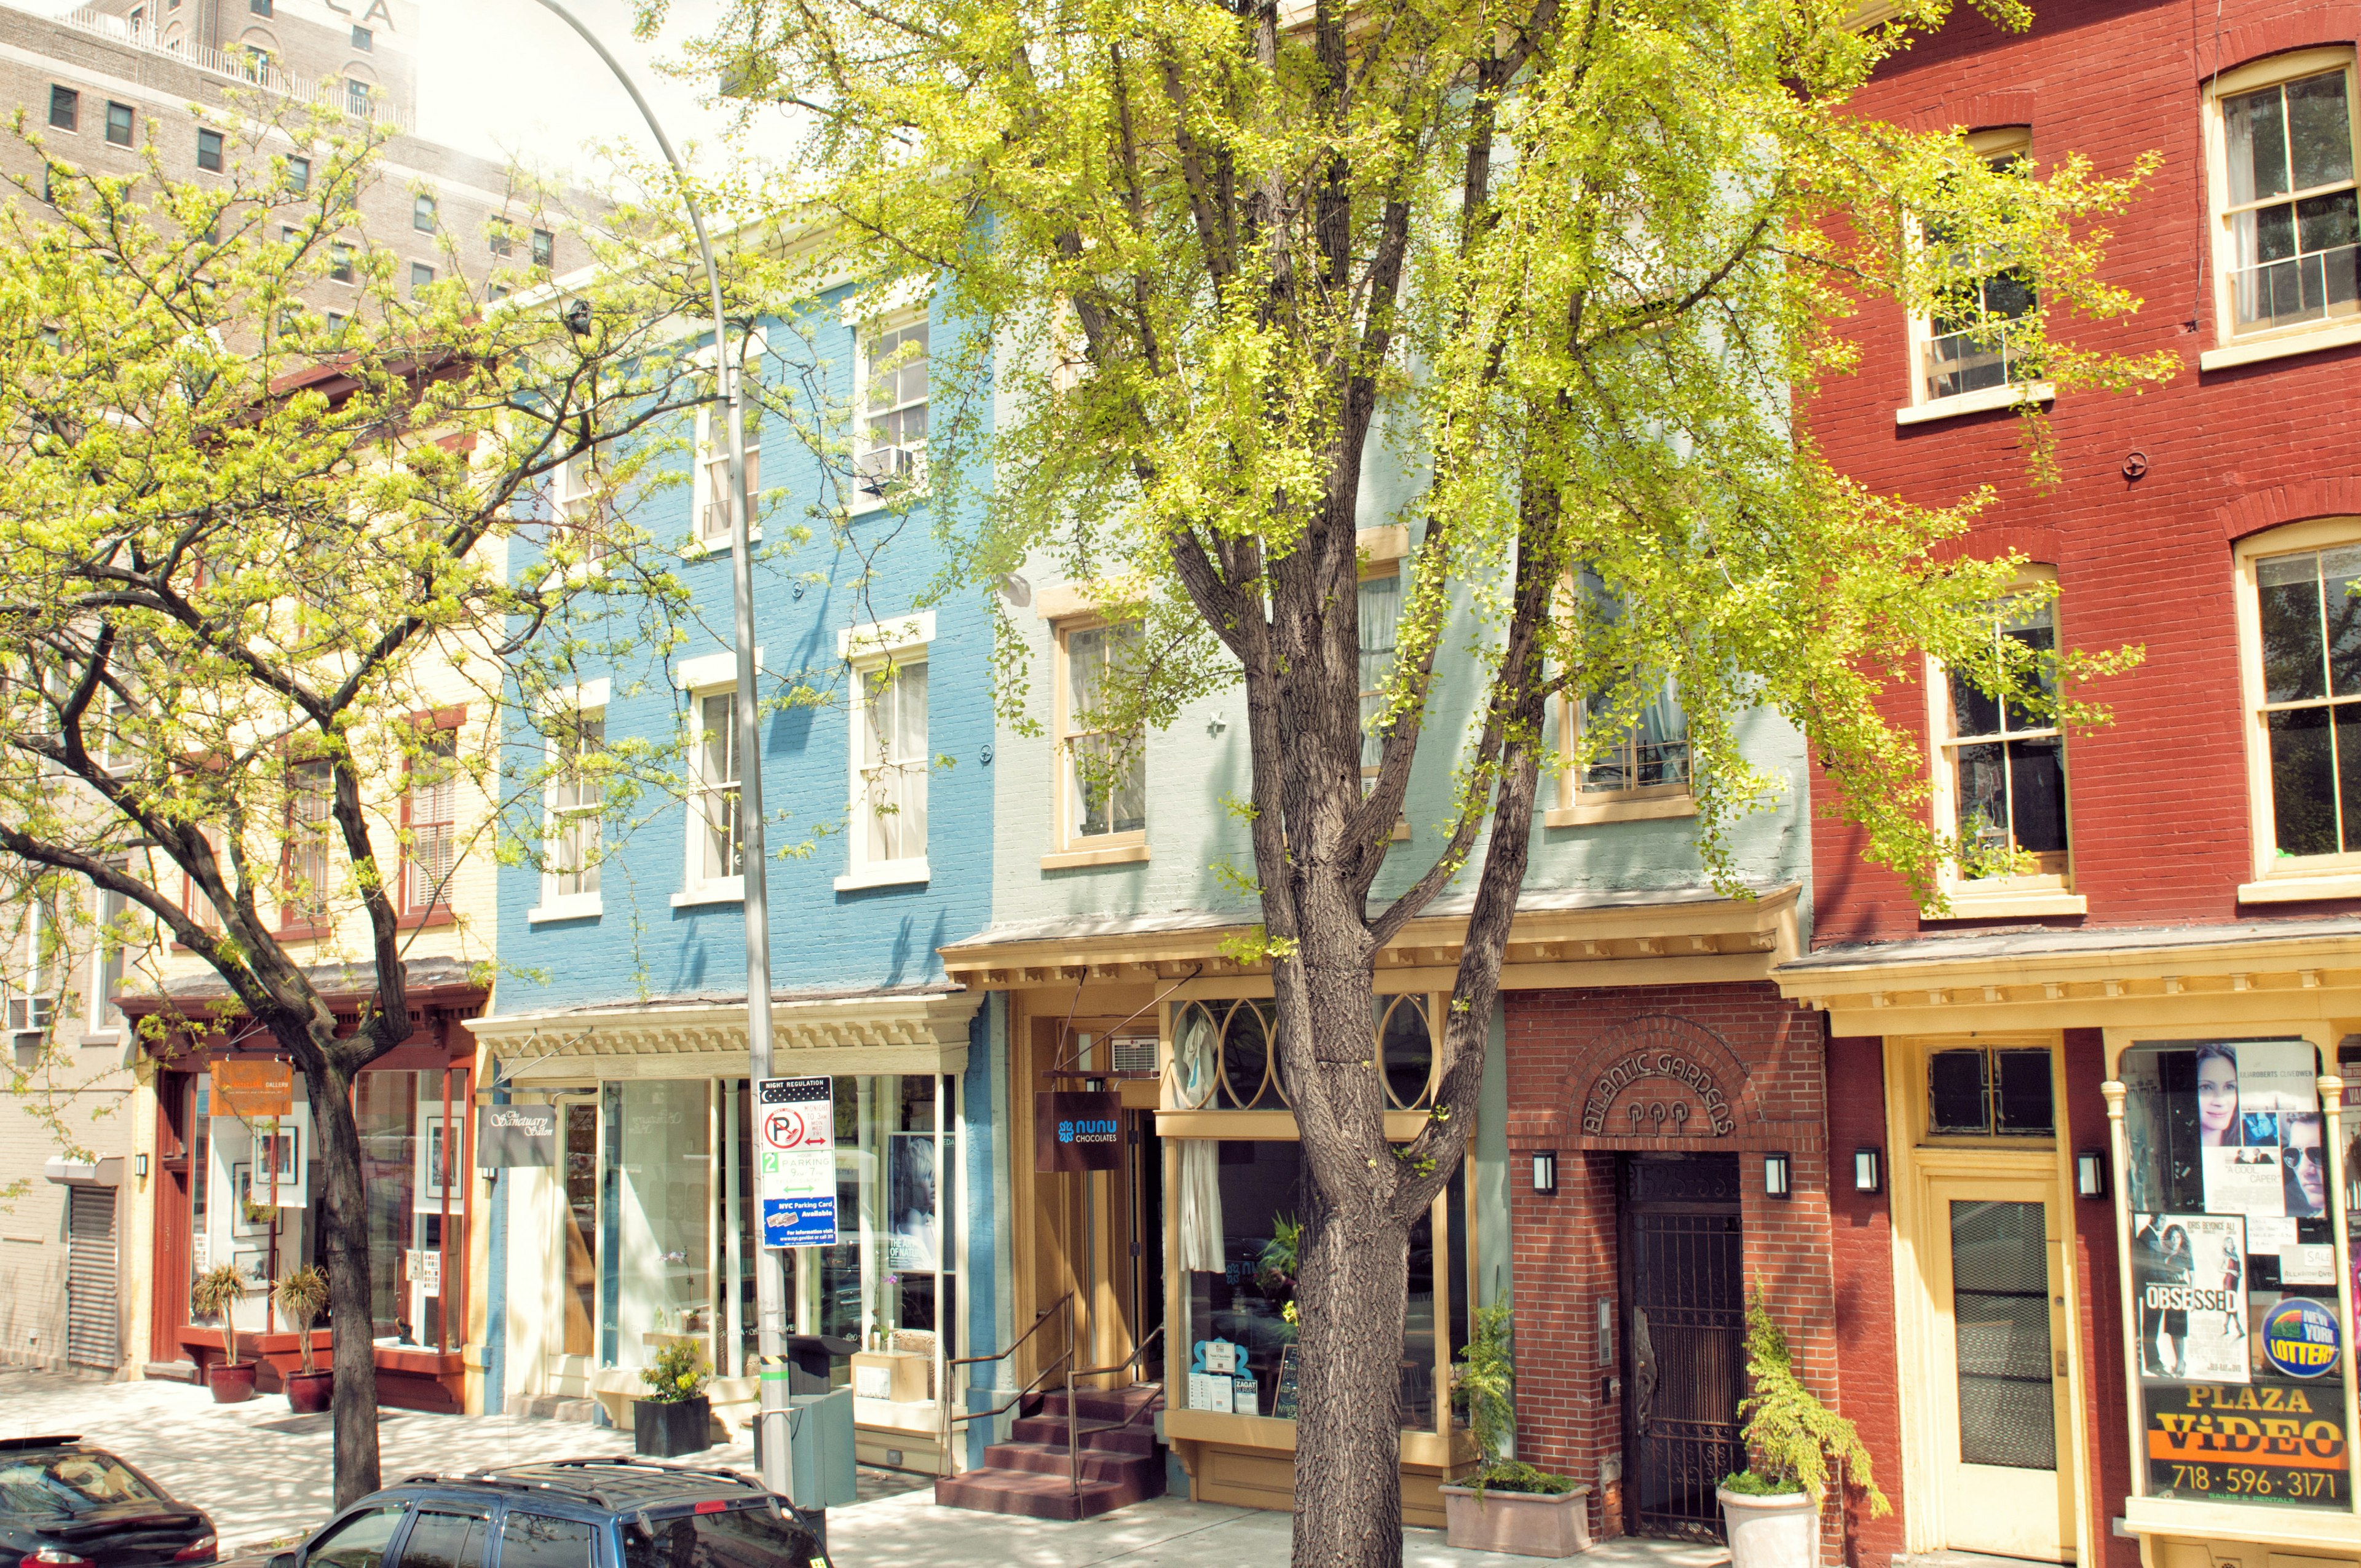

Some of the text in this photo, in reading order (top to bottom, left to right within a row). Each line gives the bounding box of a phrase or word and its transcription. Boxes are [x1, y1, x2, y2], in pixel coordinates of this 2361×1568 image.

[1583, 1054, 1734, 1135] ATLANTIC GARDENS
[2348, 1088, 2361, 1103] VA
[491, 1114, 548, 1129] Sanctuary
[1077, 1120, 1117, 1133] nunu
[524, 1126, 553, 1136] Salon
[764, 1152, 777, 1173] 2
[782, 1158, 830, 1167] PARKING
[2235, 1165, 2258, 1174] COOL
[890, 1238, 902, 1248] THE
[890, 1248, 900, 1256] OF
[2308, 1251, 2330, 1262] SALE
[2146, 1286, 2238, 1313] OBSESSED
[2303, 1309, 2328, 1327] NEW
[2304, 1323, 2334, 1344] YORK
[2271, 1339, 2335, 1365] LOTTERY
[2185, 1384, 2314, 1413] PLAZA
